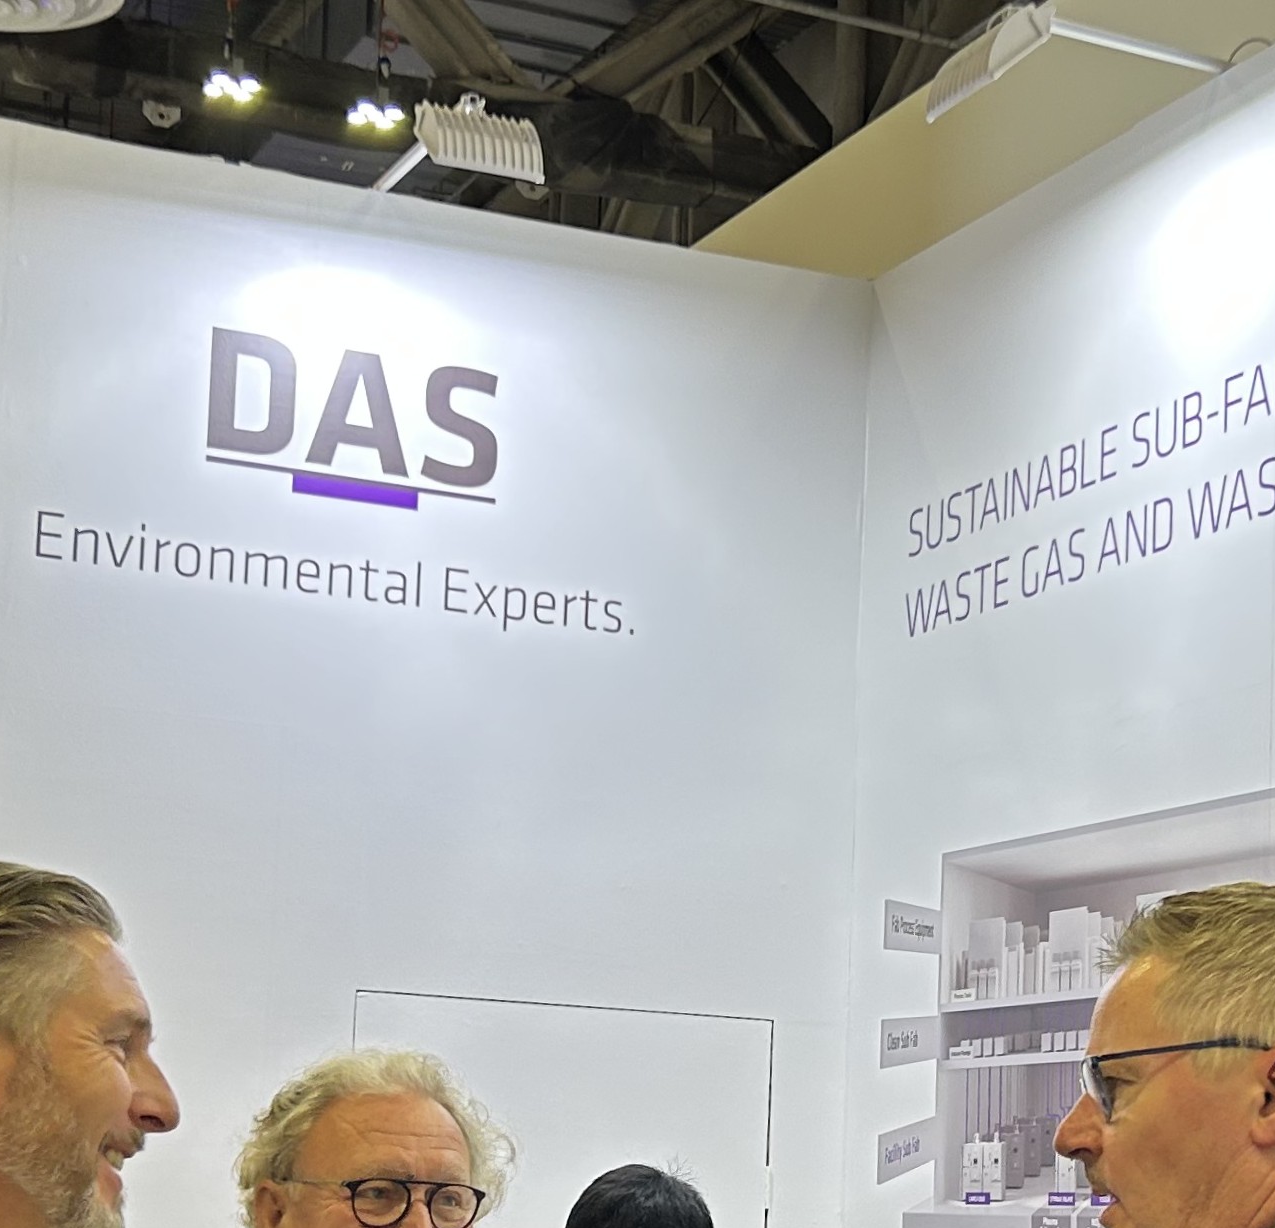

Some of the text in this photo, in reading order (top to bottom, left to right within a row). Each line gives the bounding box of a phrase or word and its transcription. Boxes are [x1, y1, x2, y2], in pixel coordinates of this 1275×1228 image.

[206, 325, 499, 489] DAS
[908, 425, 1118, 558] SUSTAINABLE
[34, 510, 635, 636] Environmental Experts.
[905, 556, 1011, 638] WASTE
[1021, 528, 1086, 599] GAS
[1097, 497, 1173, 573] AND
